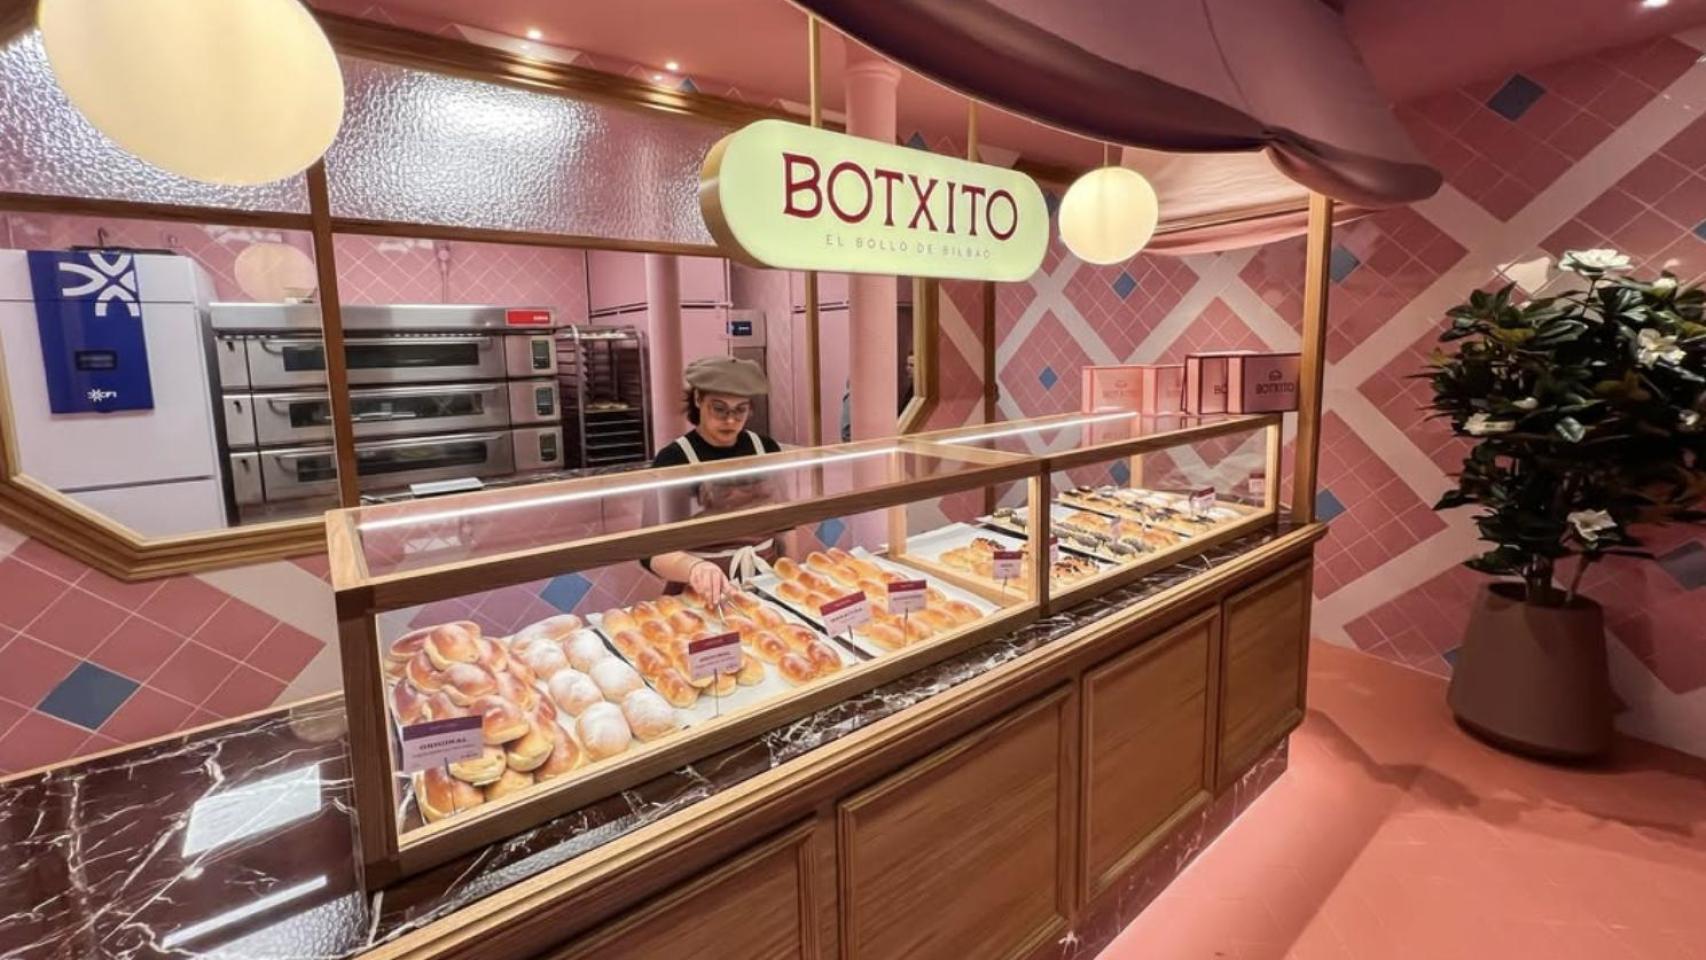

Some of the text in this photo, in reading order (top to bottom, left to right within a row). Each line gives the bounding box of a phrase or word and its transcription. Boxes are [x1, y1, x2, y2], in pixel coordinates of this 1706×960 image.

[782, 152, 1018, 242] BOTXITO
[826, 234, 845, 247] EL
[855, 237, 908, 252] BOLLO
[917, 242, 934, 255] DE
